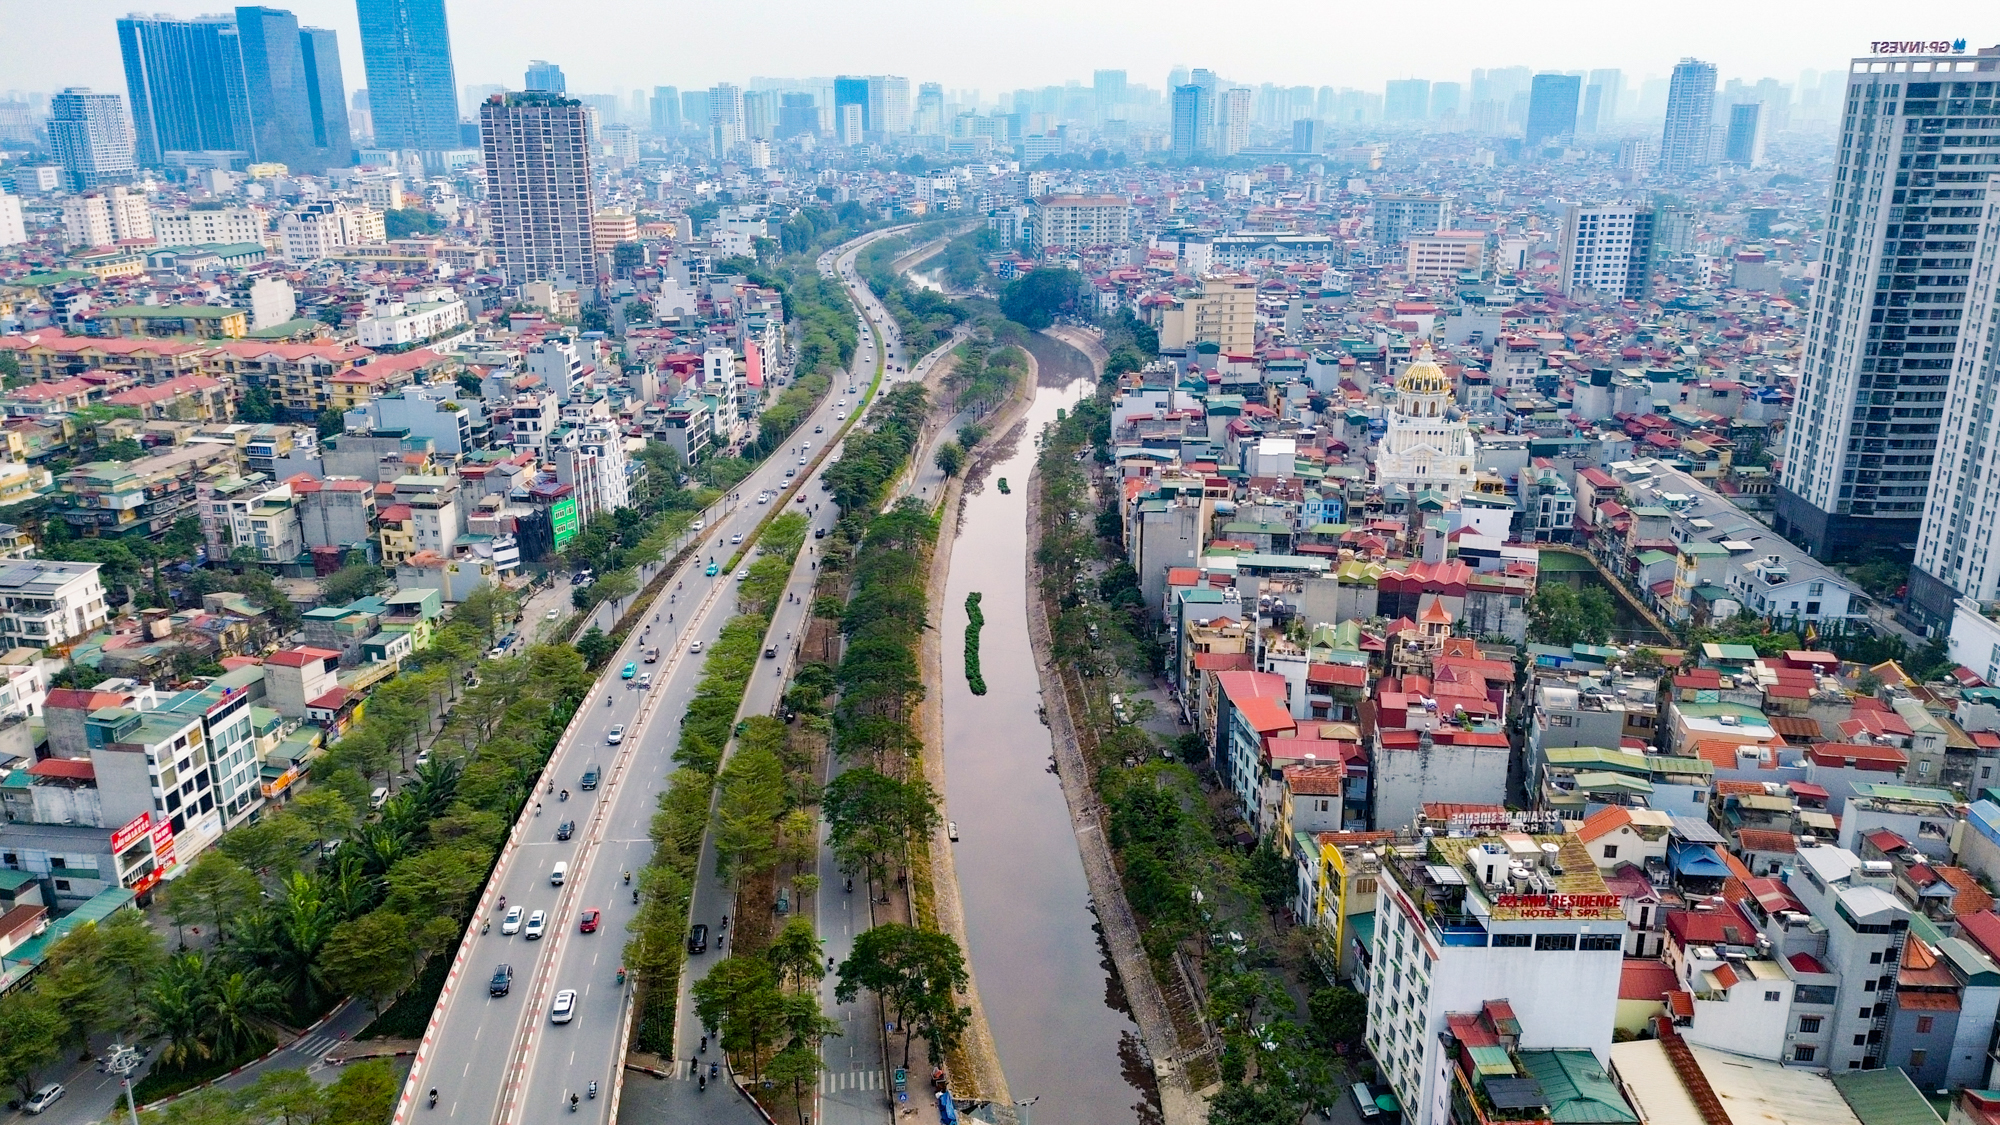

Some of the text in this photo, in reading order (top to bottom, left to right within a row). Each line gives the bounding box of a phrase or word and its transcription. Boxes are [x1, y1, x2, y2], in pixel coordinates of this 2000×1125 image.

[452, 153, 476, 162] LOTTE
[1551, 894, 1621, 907] RESIDENCE
[1521, 909, 1600, 918] HOTEL & SPA
